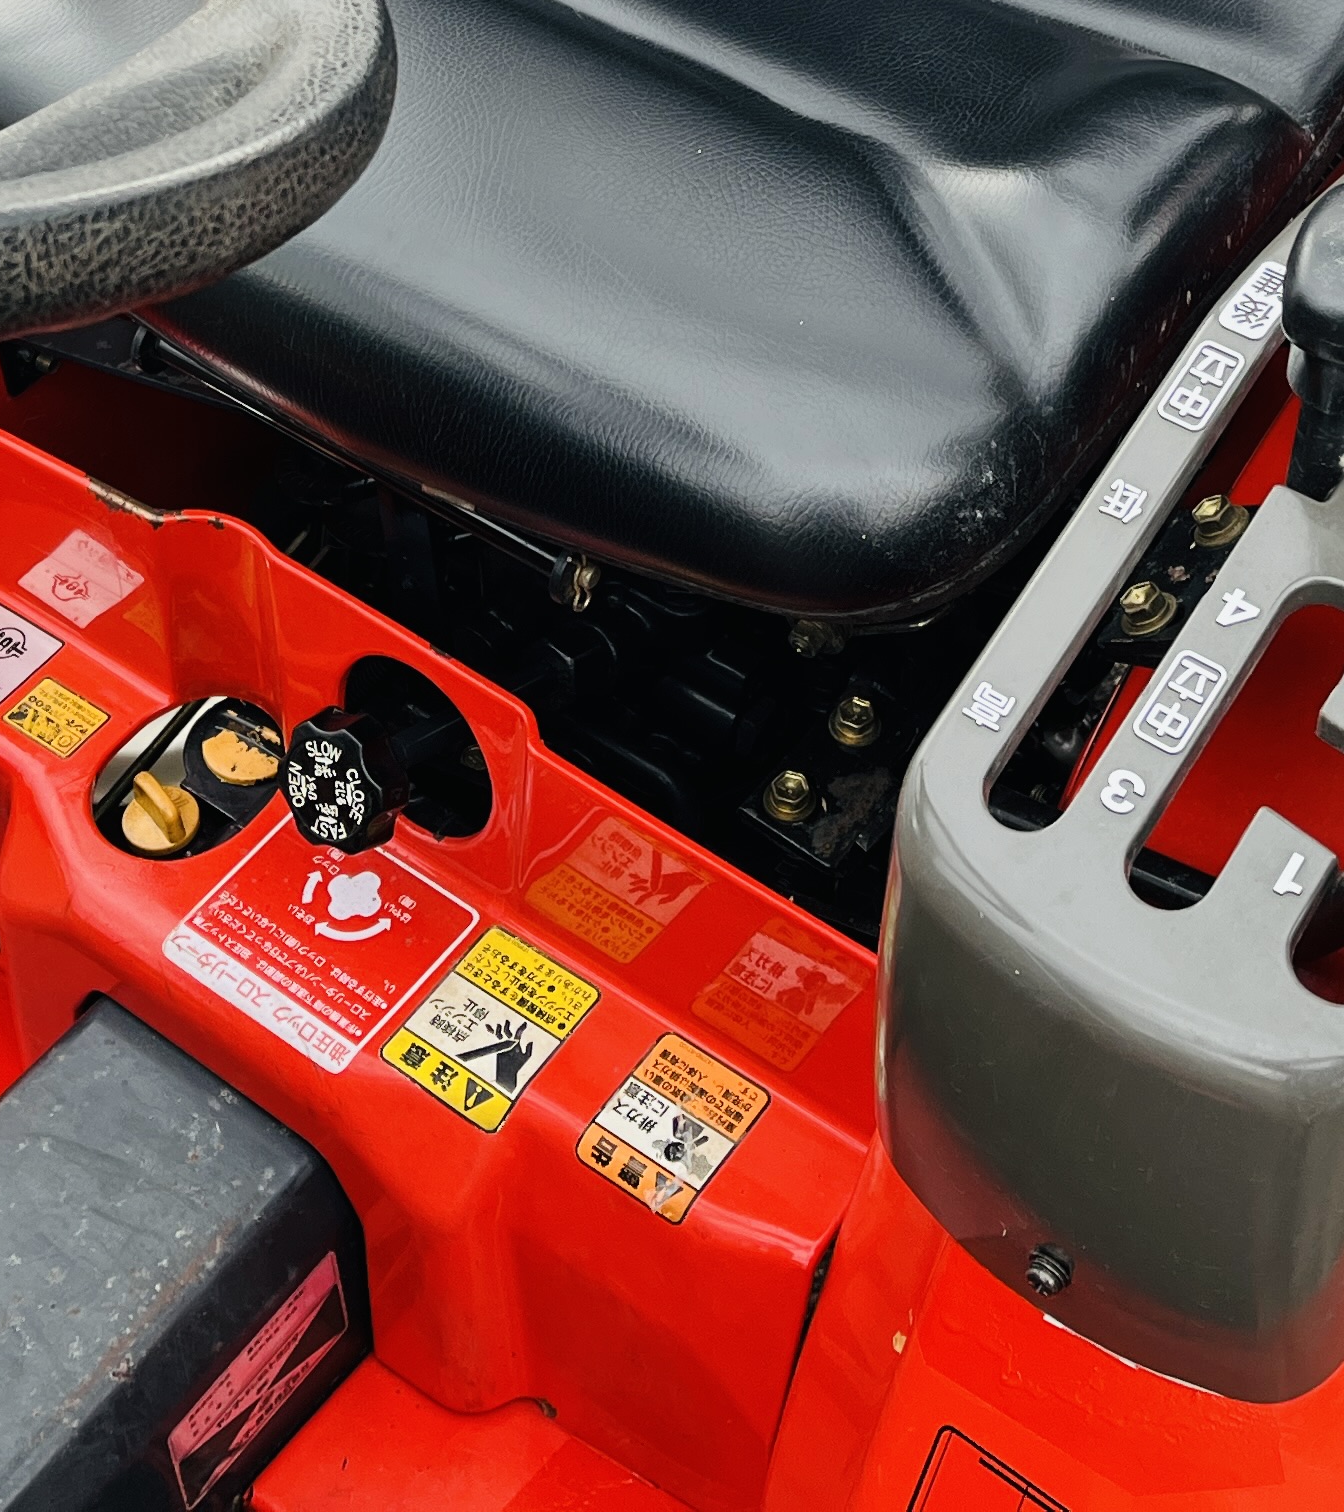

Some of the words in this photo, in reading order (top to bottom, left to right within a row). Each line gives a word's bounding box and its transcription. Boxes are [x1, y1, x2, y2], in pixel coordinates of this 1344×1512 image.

[1166, 347, 1239, 424] 中立
[1097, 476, 1147, 525] 低
[1219, 587, 1263, 628] 4
[961, 680, 1019, 734] 高
[1142, 656, 1221, 748] 中立
[304, 740, 342, 761] SLOW
[287, 760, 305, 807] OPEN
[345, 768, 364, 825] CLOSE
[1099, 767, 1148, 815] 3
[310, 817, 347, 839] FAST
[310, 853, 340, 876] ロック
[1271, 853, 1310, 897] 1
[379, 900, 414, 924] はやい
[427, 995, 480, 1032] エンジン
[427, 1013, 470, 1045] 点検時
[459, 997, 491, 1021] 停止
[395, 1040, 462, 1093] 注意
[609, 1097, 658, 1135] 排ガス
[621, 1079, 671, 1118] に注意
[584, 1134, 652, 1190] 警告
